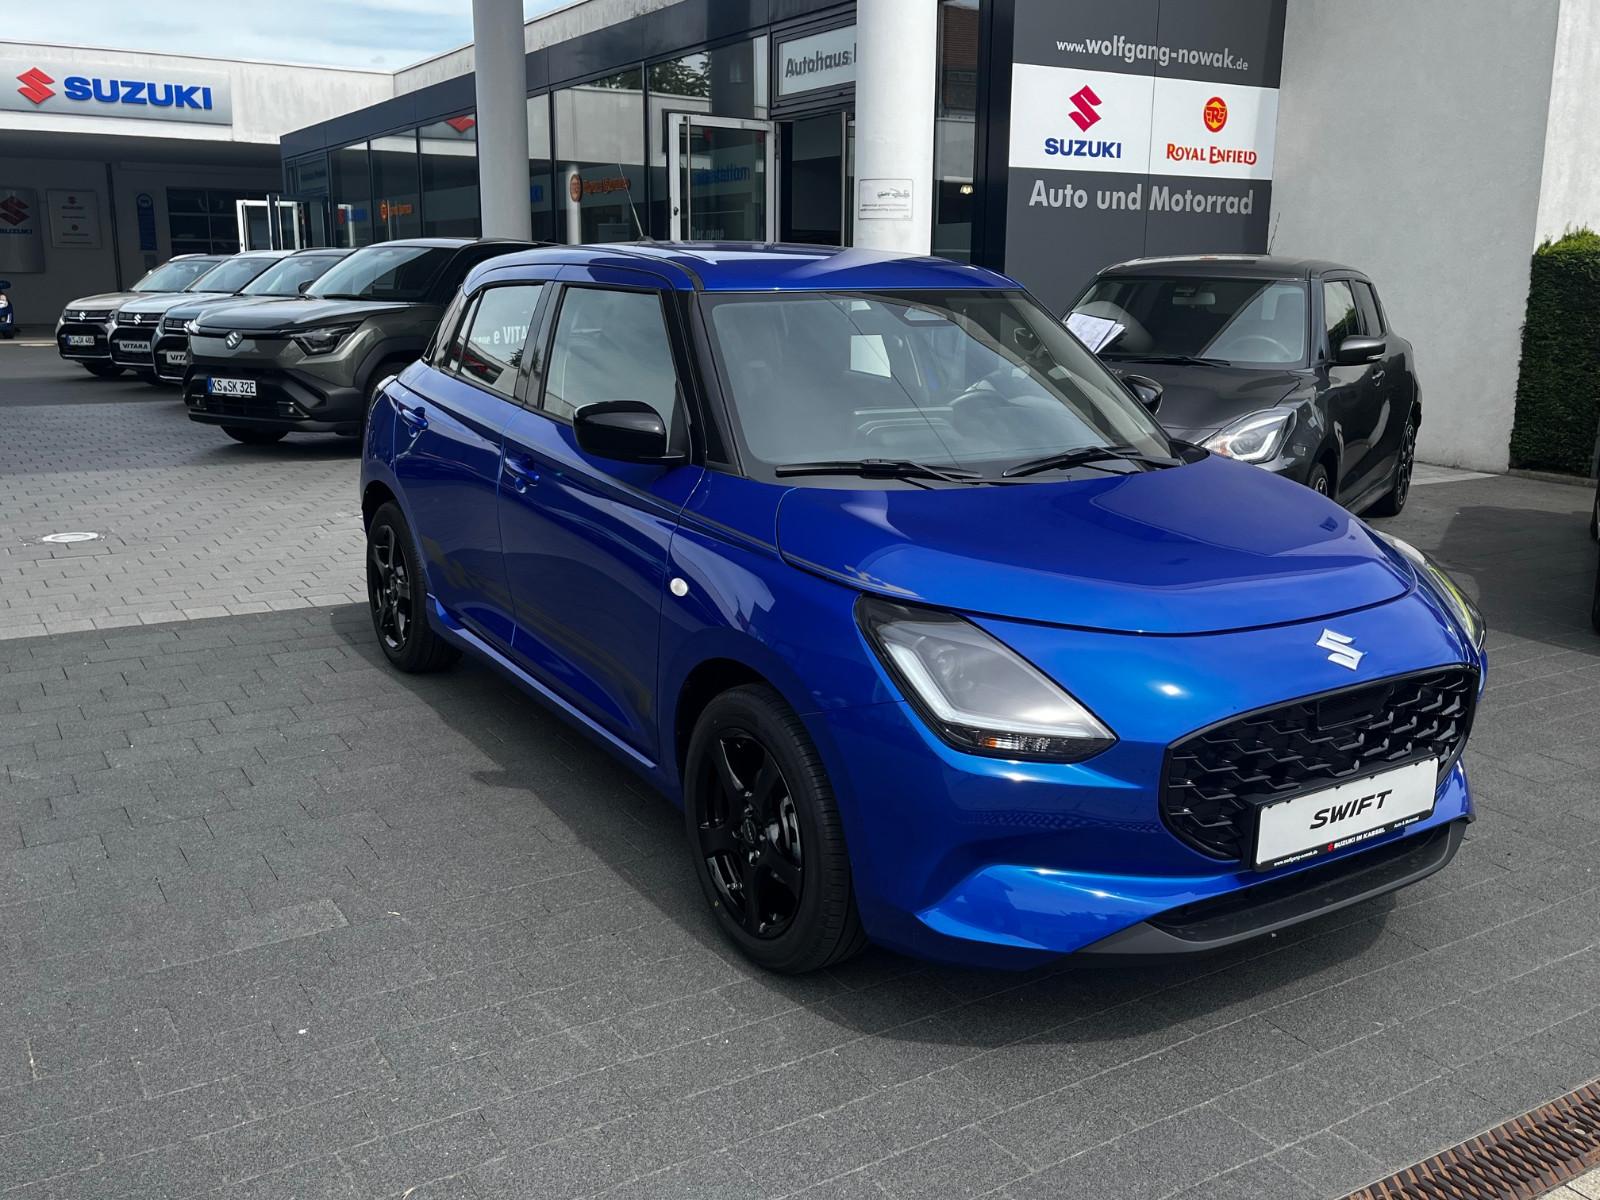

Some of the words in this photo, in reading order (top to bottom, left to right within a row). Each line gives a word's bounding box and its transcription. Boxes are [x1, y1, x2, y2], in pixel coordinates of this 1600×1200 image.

[785, 50, 851, 78] Autohaus
[1056, 35, 1249, 72] www.wolfgang-nowak.de
[64, 76, 213, 110] SUZUKI
[1044, 137, 1122, 159] SUZUKI
[1029, 179, 1088, 209] Auto
[1096, 183, 1142, 211] und
[1149, 185, 1254, 215] Motorrad
[493, 330, 501, 345] e
[502, 325, 529, 345] VITA
[212, 380, 222, 392] KS
[227, 381, 238, 393] SK
[240, 382, 256, 394] 32E
[1309, 789, 1393, 830] SWIFT
[1334, 837, 1355, 849] SUZUKI
[1356, 834, 1363, 842] IN
[1363, 827, 1386, 840] KASSEL
